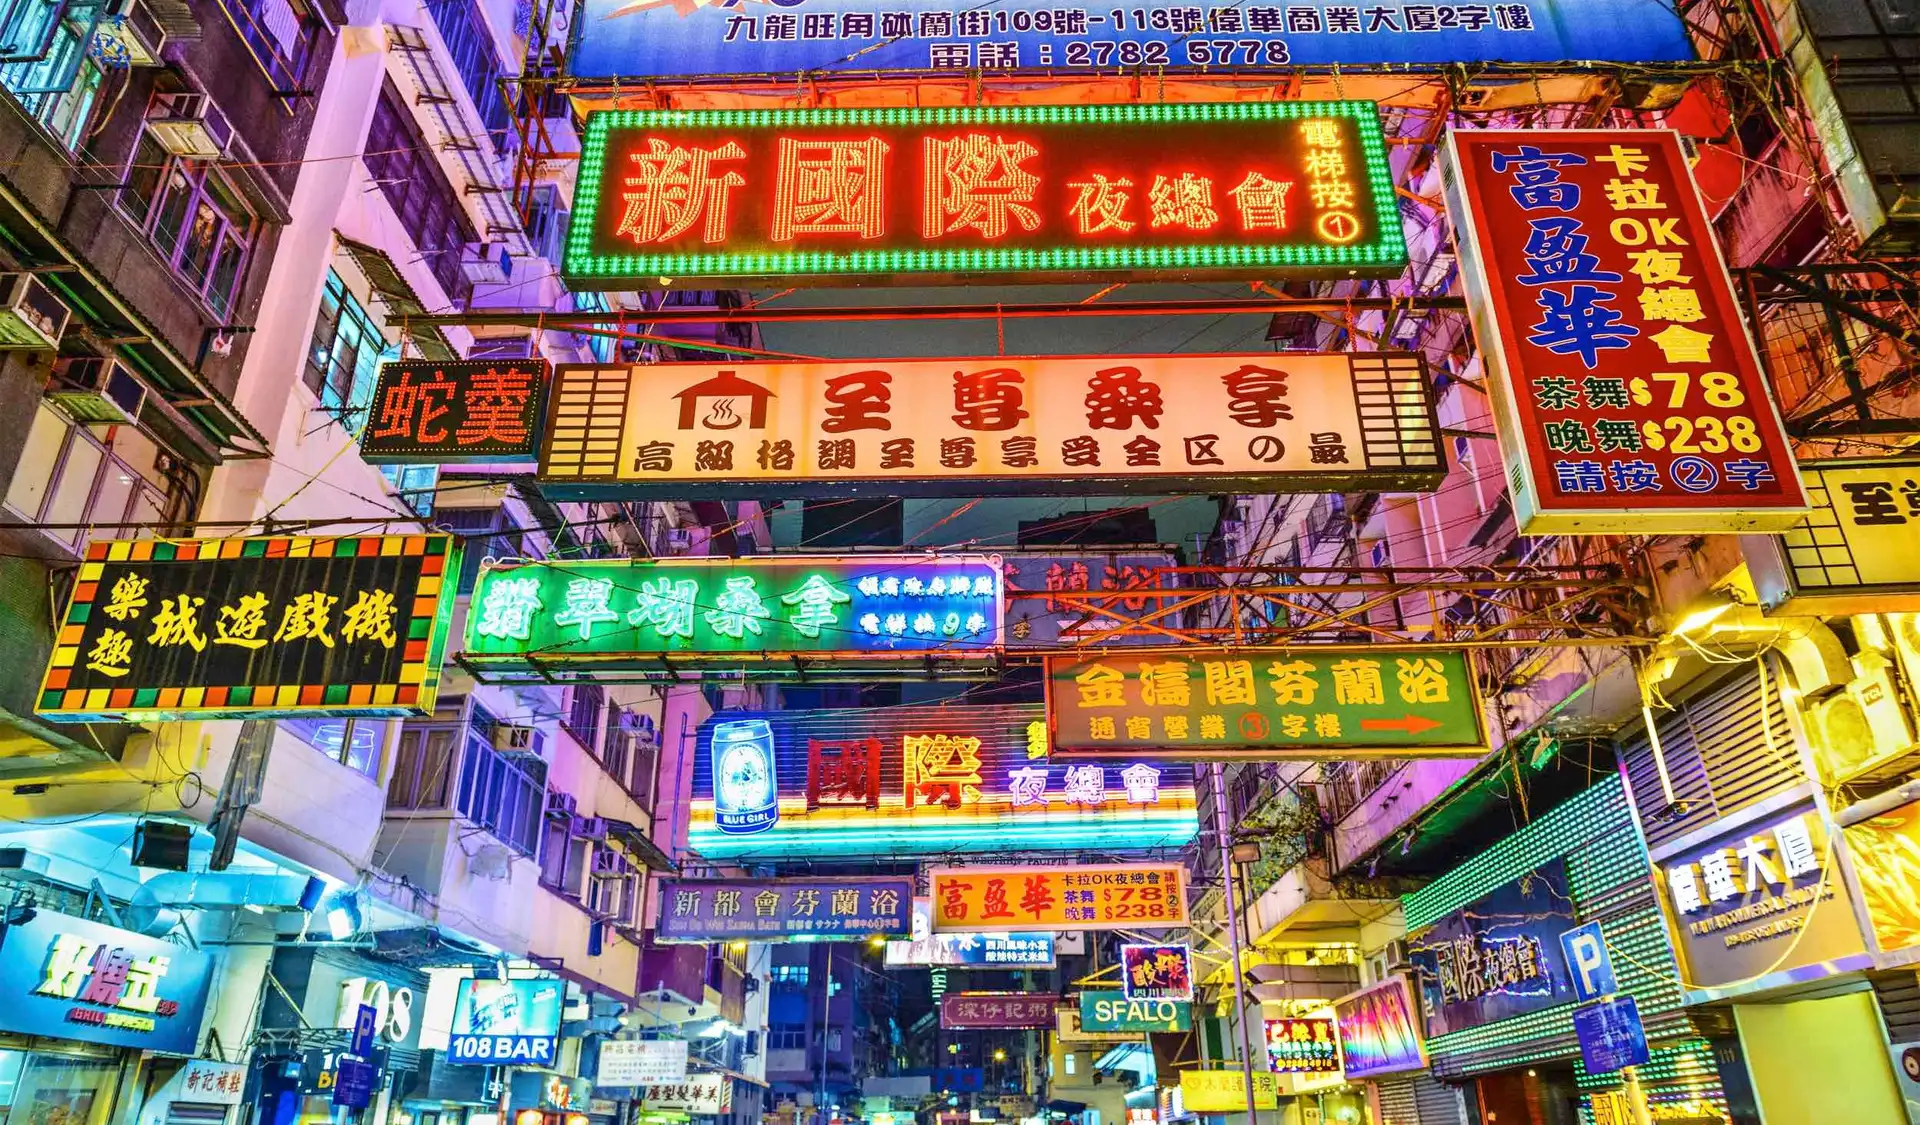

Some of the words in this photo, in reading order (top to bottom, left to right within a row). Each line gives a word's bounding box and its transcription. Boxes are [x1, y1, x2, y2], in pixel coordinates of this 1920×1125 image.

[1187, 40, 1290, 64] 5778
[615, 132, 1042, 243] 新國際
[1067, 170, 1294, 234] 夜總會
[1490, 145, 1640, 370] 富盈華
[1594, 144, 1714, 364] 卡拉OK夜總會
[375, 367, 533, 445] 蛇羹
[820, 364, 1294, 434] 至尊桑拿
[1075, 657, 1450, 709] 金濤閣芬蘭浴
[805, 732, 983, 813] 國際
[1008, 763, 1162, 807] 夜總會
[723, 814, 747, 824] BLUE
[747, 812, 769, 823] GIRL
[939, 874, 1056, 921] 富盈華
[1062, 871, 1161, 886] 卡拉OK夜總會
[1064, 889, 1096, 904] 茶舞
[672, 889, 900, 917] 新都會芬蘭浴
[1064, 907, 1097, 921] 晚舞
[1571, 933, 1601, 995] P
[355, 1010, 372, 1051] P
[1095, 1000, 1177, 1022] SFALO
[453, 1036, 491, 1059] 108
[495, 1037, 549, 1059] BAR
